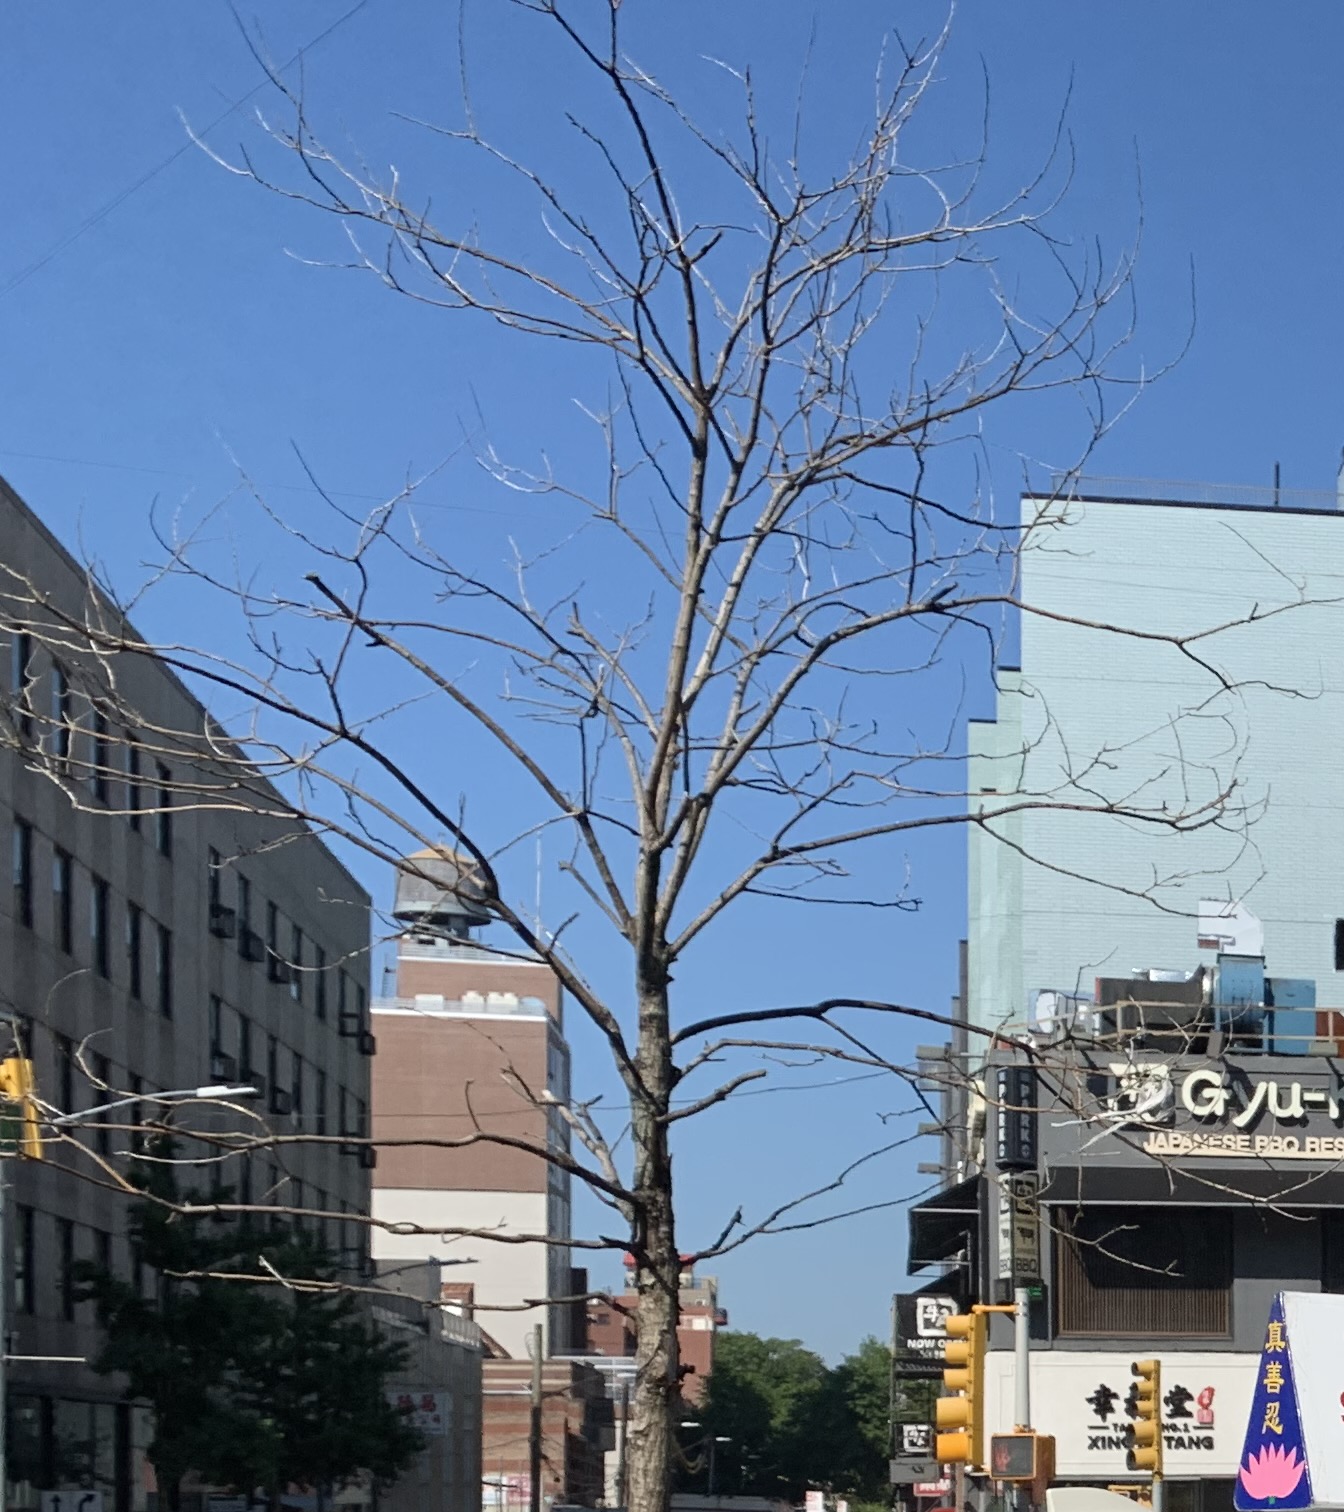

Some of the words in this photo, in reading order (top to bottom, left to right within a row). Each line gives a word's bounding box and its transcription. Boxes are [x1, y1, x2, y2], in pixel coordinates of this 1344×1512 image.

[1144, 1132, 1251, 1152] JAPANESE
[1255, 1134, 1299, 1153] BBQ
[907, 1339, 935, 1348] NOW
[1262, 1320, 1285, 1435] 真善忍
[1163, 1436, 1214, 1450] TANG
